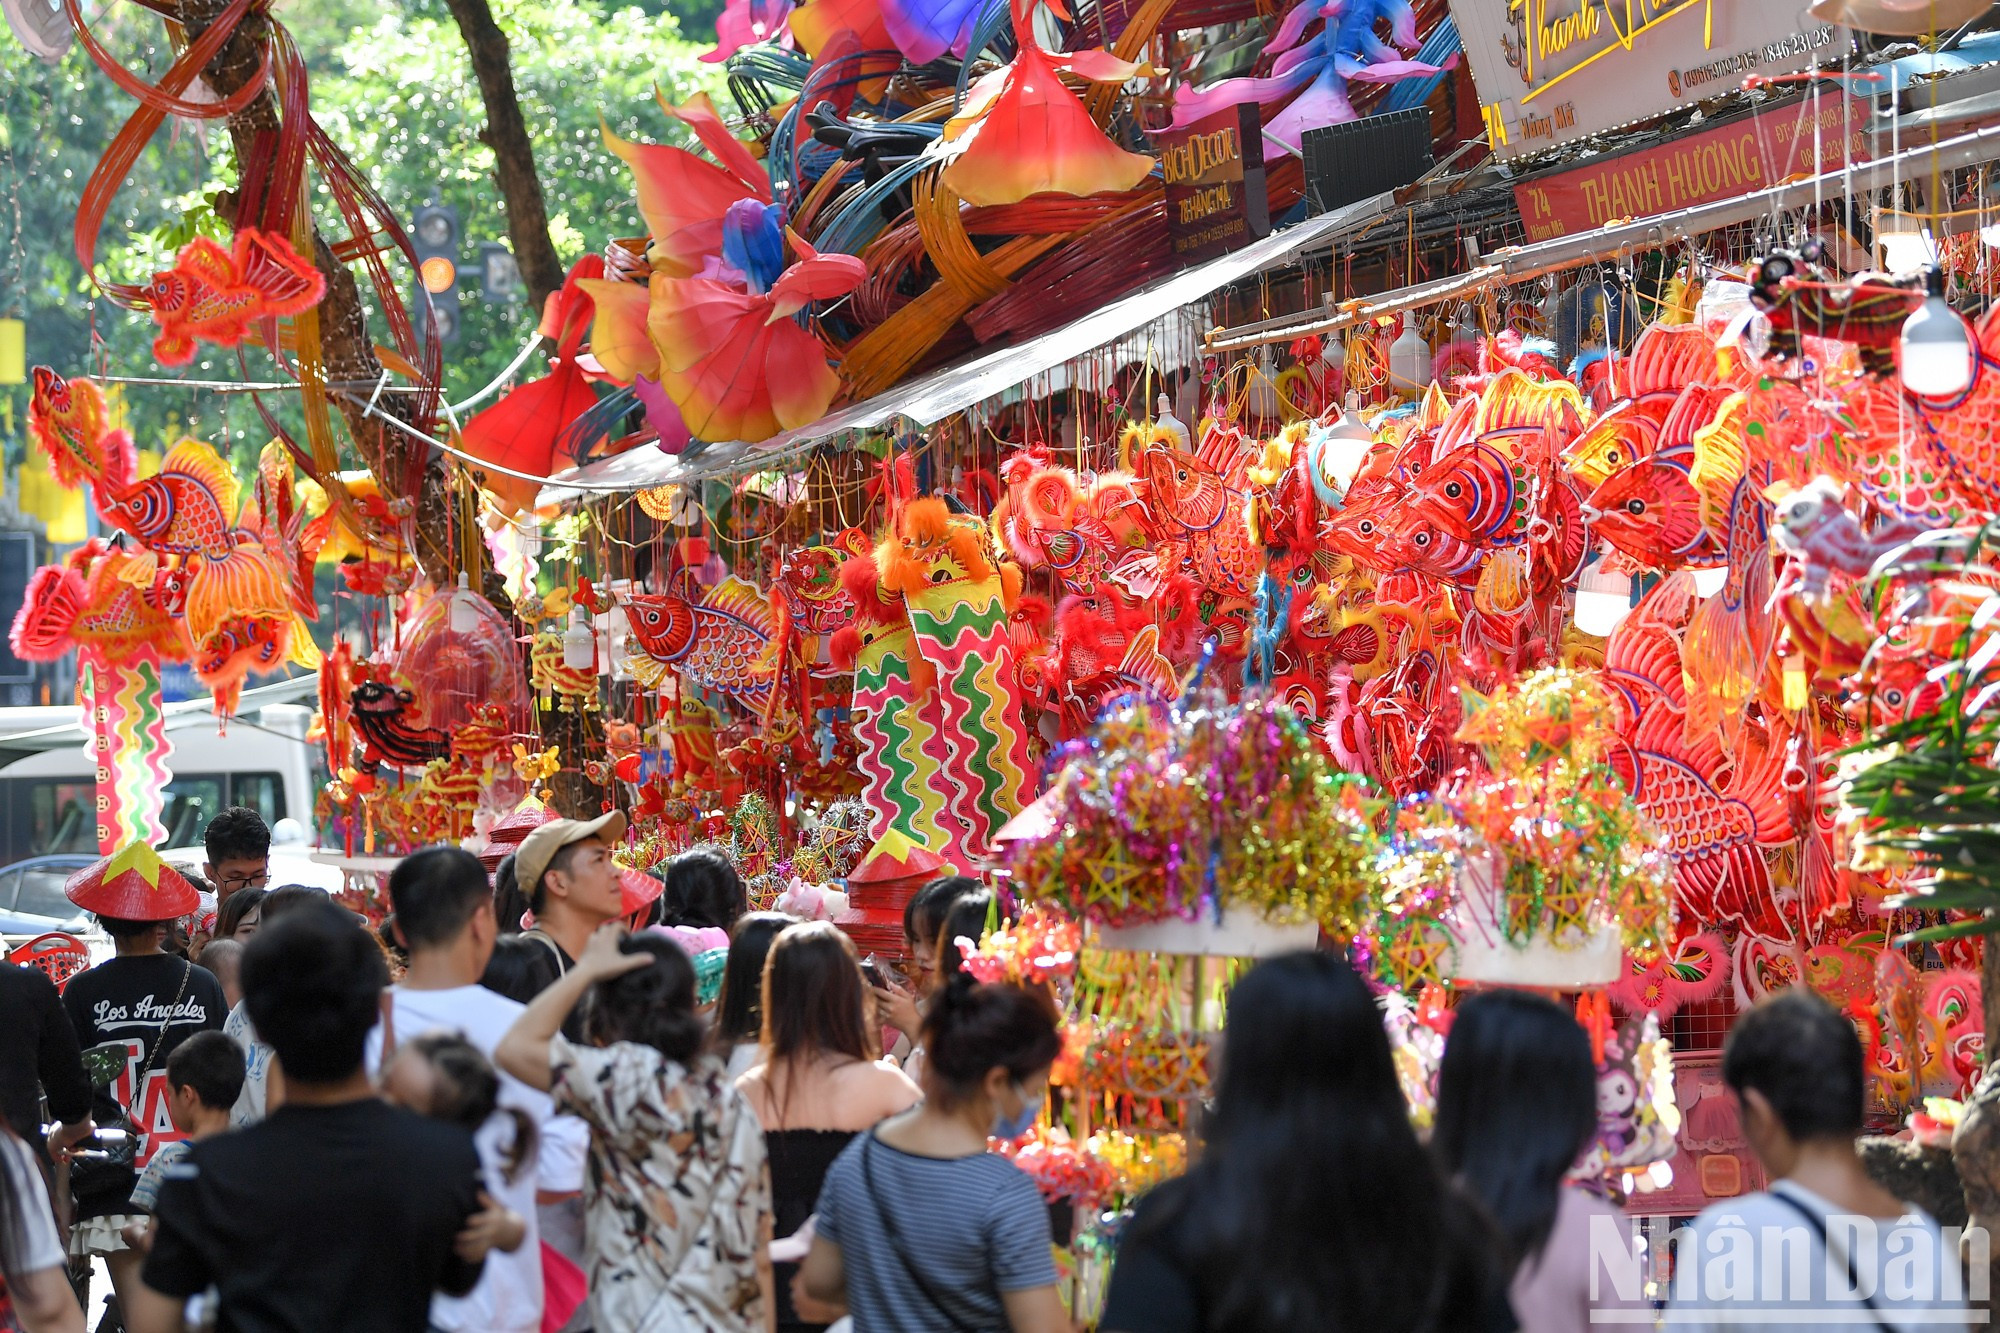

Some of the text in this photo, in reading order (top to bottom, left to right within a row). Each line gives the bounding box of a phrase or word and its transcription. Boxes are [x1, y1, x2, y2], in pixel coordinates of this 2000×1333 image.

[1481, 102, 1508, 151] 74
[1580, 133, 1761, 225] THANH HƯƠNG
[1527, 187, 1552, 219] 74
[93, 994, 206, 1033] Los Angeles
